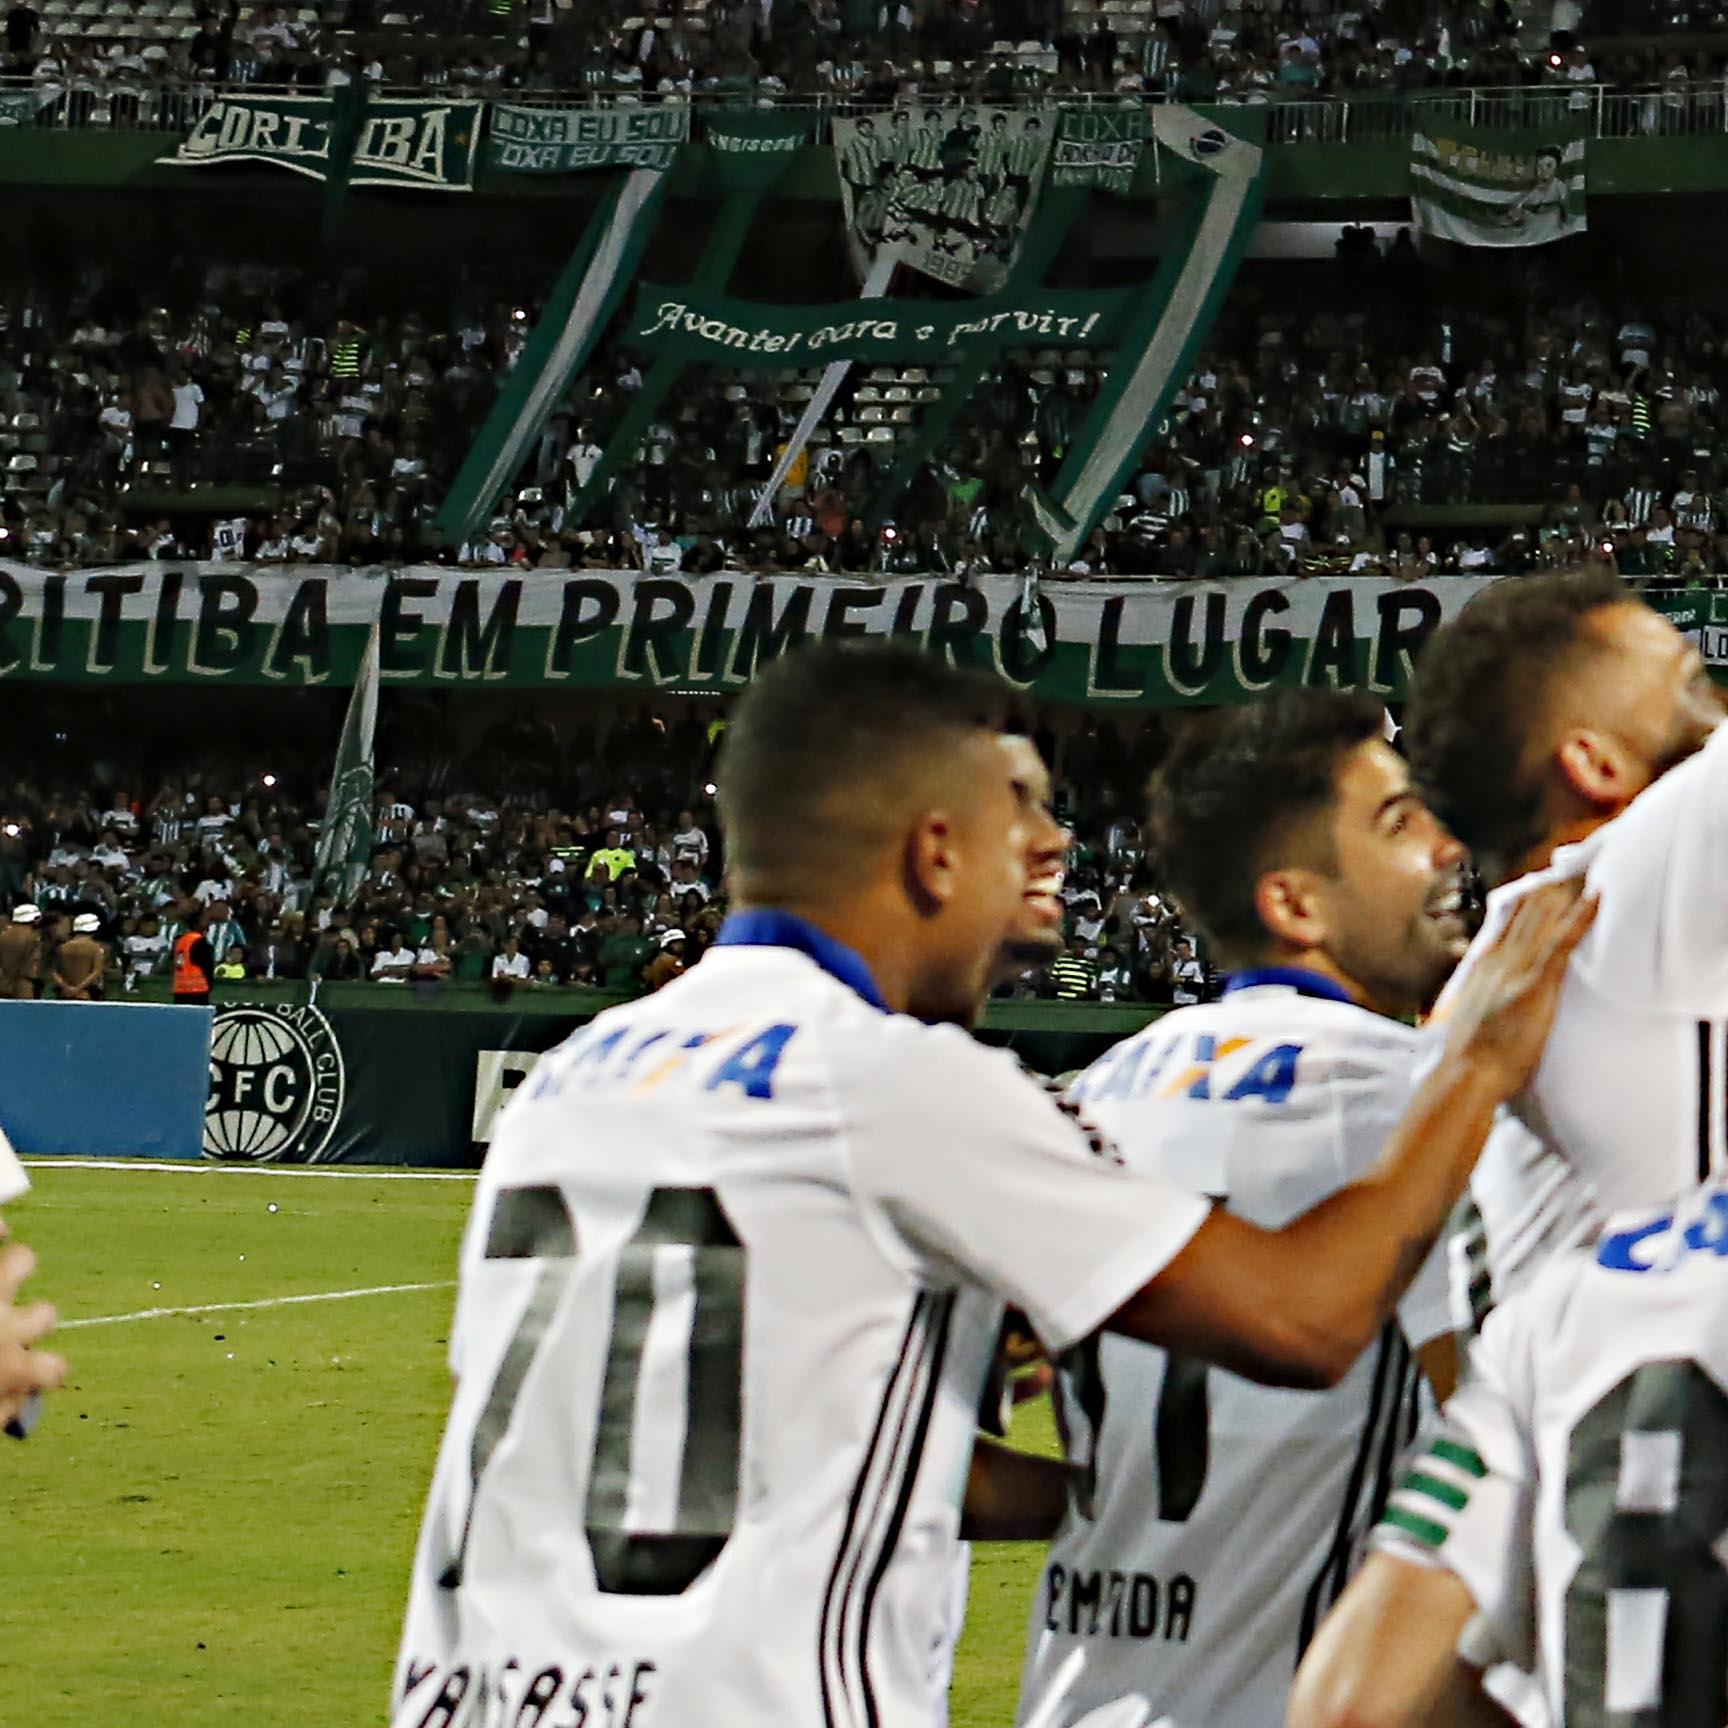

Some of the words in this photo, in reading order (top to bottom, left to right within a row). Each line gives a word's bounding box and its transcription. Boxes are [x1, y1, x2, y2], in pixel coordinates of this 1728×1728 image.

[182, 100, 452, 183] CORIIBA
[568, 145, 611, 167] EU
[615, 145, 677, 168] SOU
[579, 116, 616, 142] EU
[627, 111, 682, 141] SOU
[1063, 113, 1144, 142] COXA
[640, 302, 802, 353] Avante!
[808, 318, 897, 349] para
[380, 576, 521, 680] EM
[553, 577, 1058, 686] PRIMEIRO
[1087, 586, 1442, 698] LUGAR
[312, 1053, 338, 1123] CLUB
[532, 1020, 800, 1101] AIXA
[437, 1183, 748, 1595] 70
